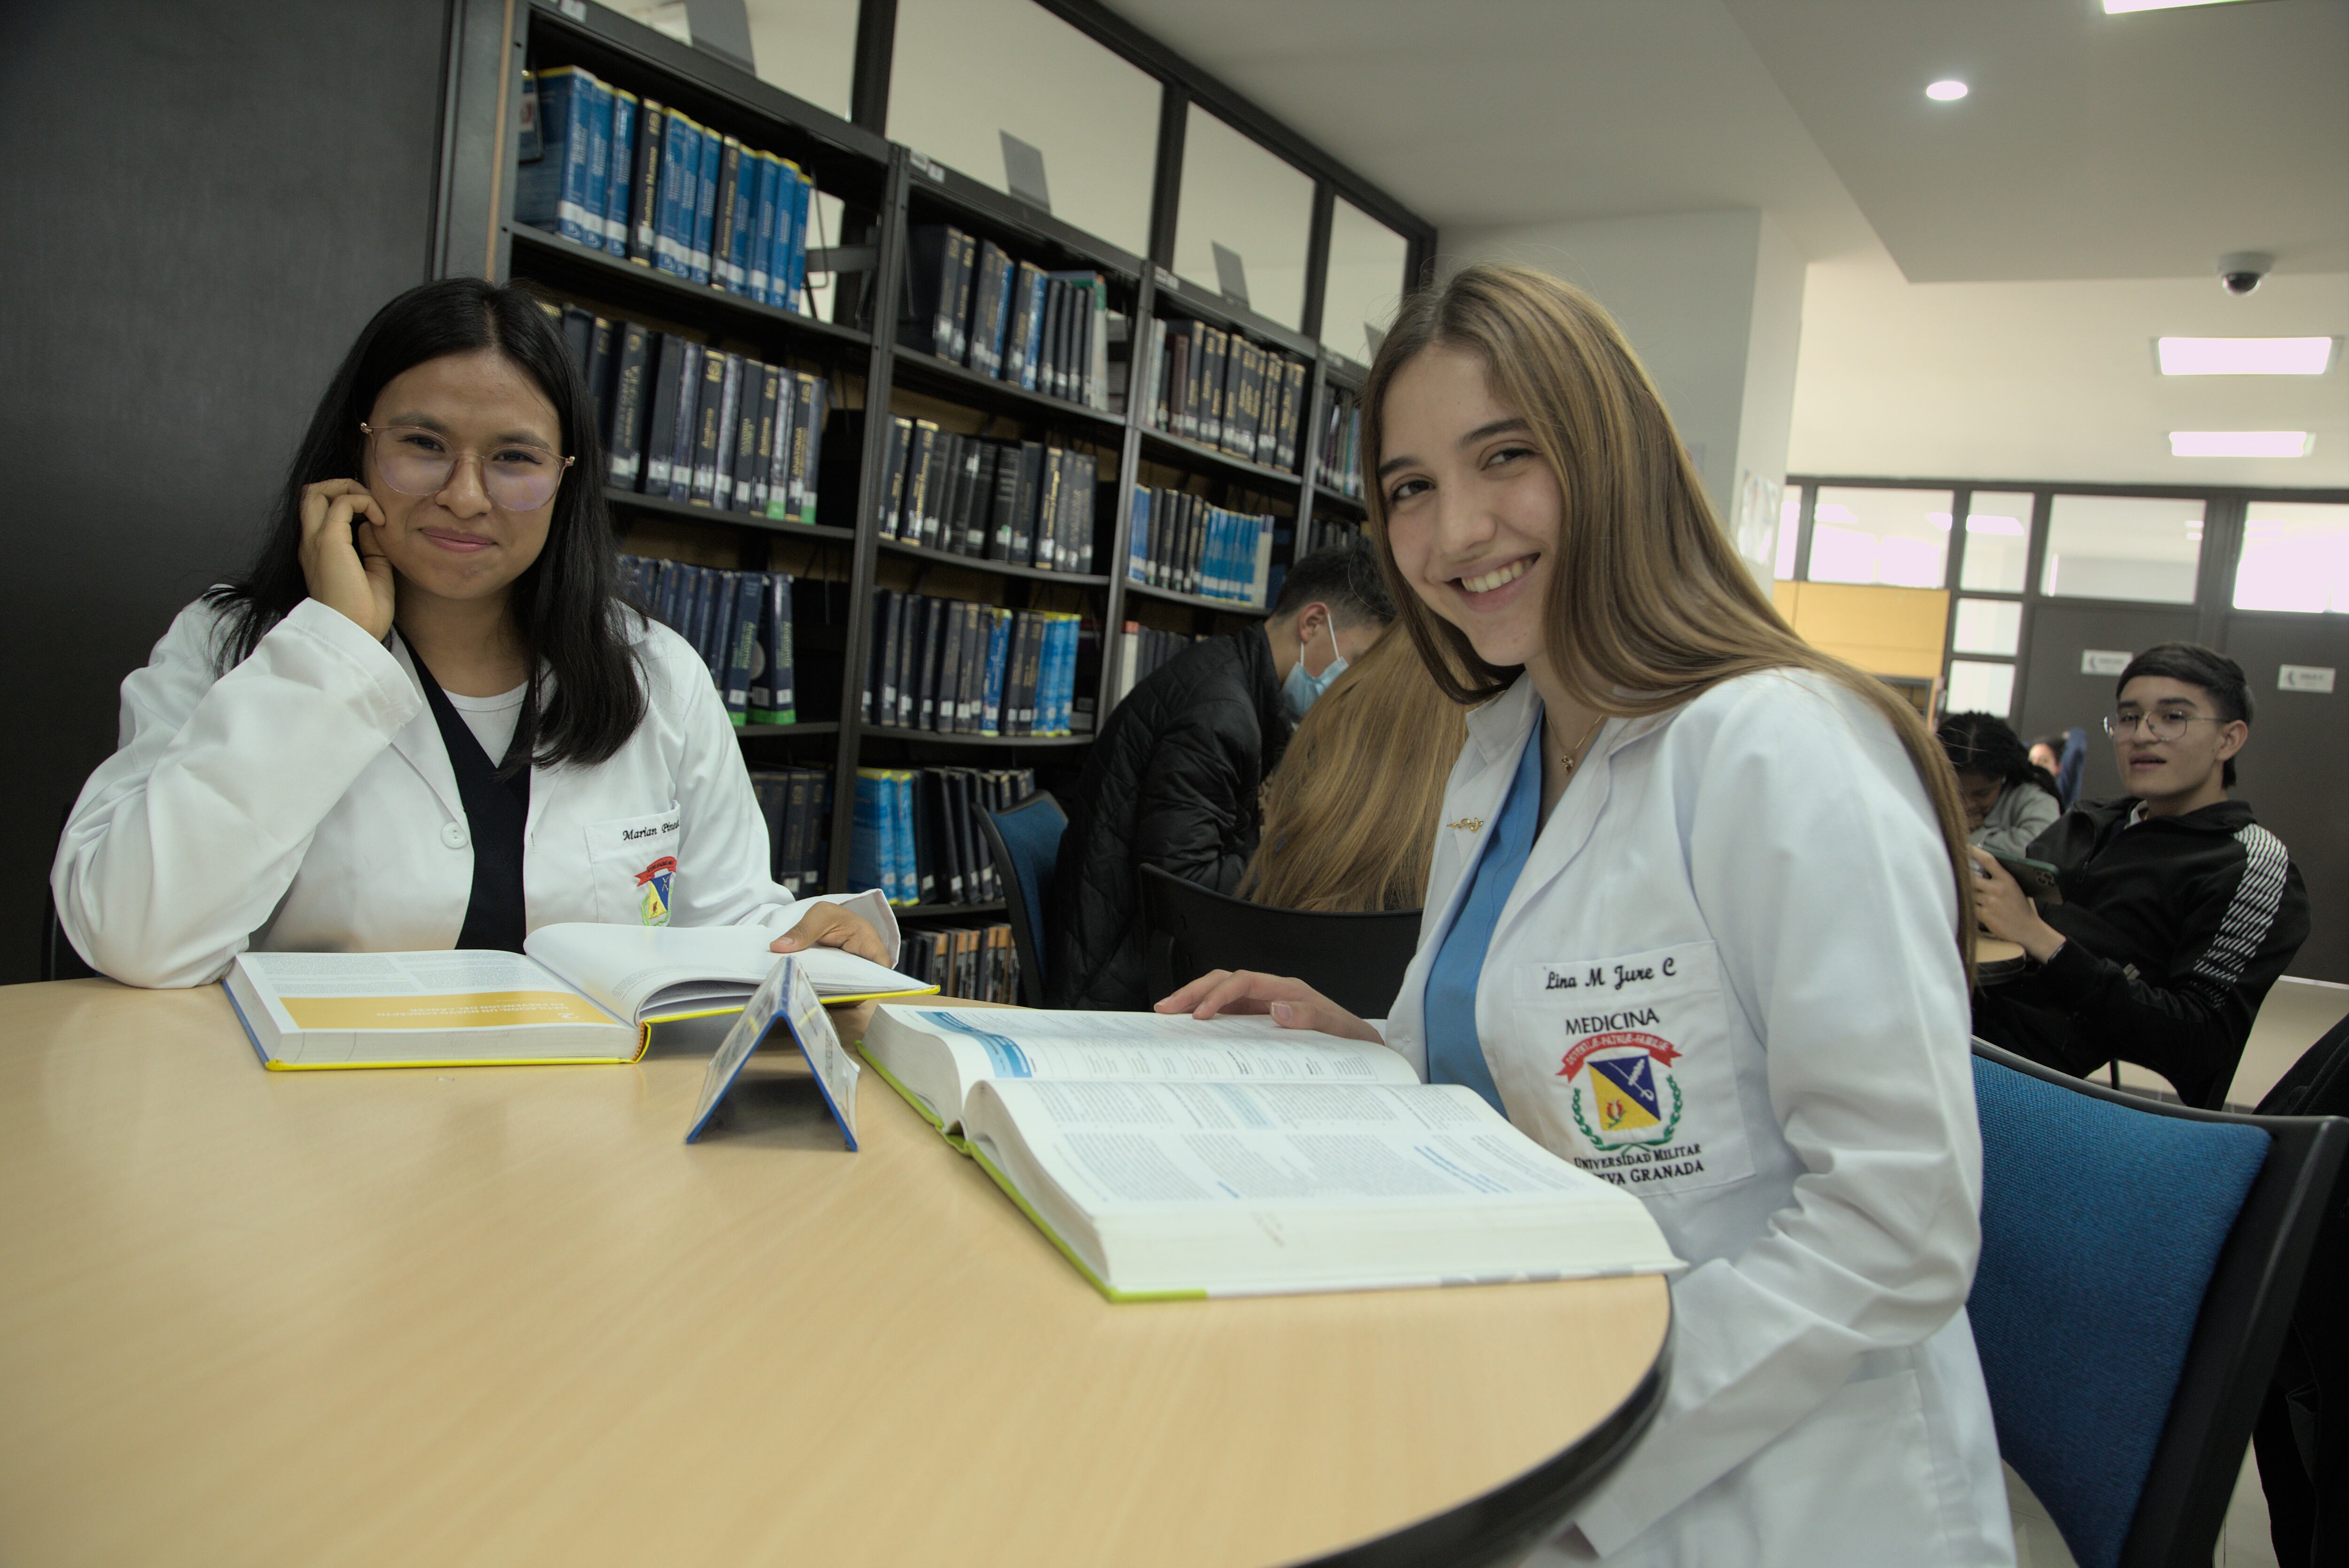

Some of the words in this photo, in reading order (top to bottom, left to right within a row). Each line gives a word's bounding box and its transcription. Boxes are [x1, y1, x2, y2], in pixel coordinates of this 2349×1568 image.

[622, 826, 658, 841] Marian
[1545, 970, 1578, 990] Lina
[1585, 967, 1606, 987] M
[1663, 956, 1677, 976] C
[1565, 1008, 1660, 1035] MEDICINA
[1574, 1153, 1651, 1170] UNIVERSIDAD
[1654, 1143, 1701, 1161] MILITAR
[1630, 1160, 1703, 1182] GRANADA
